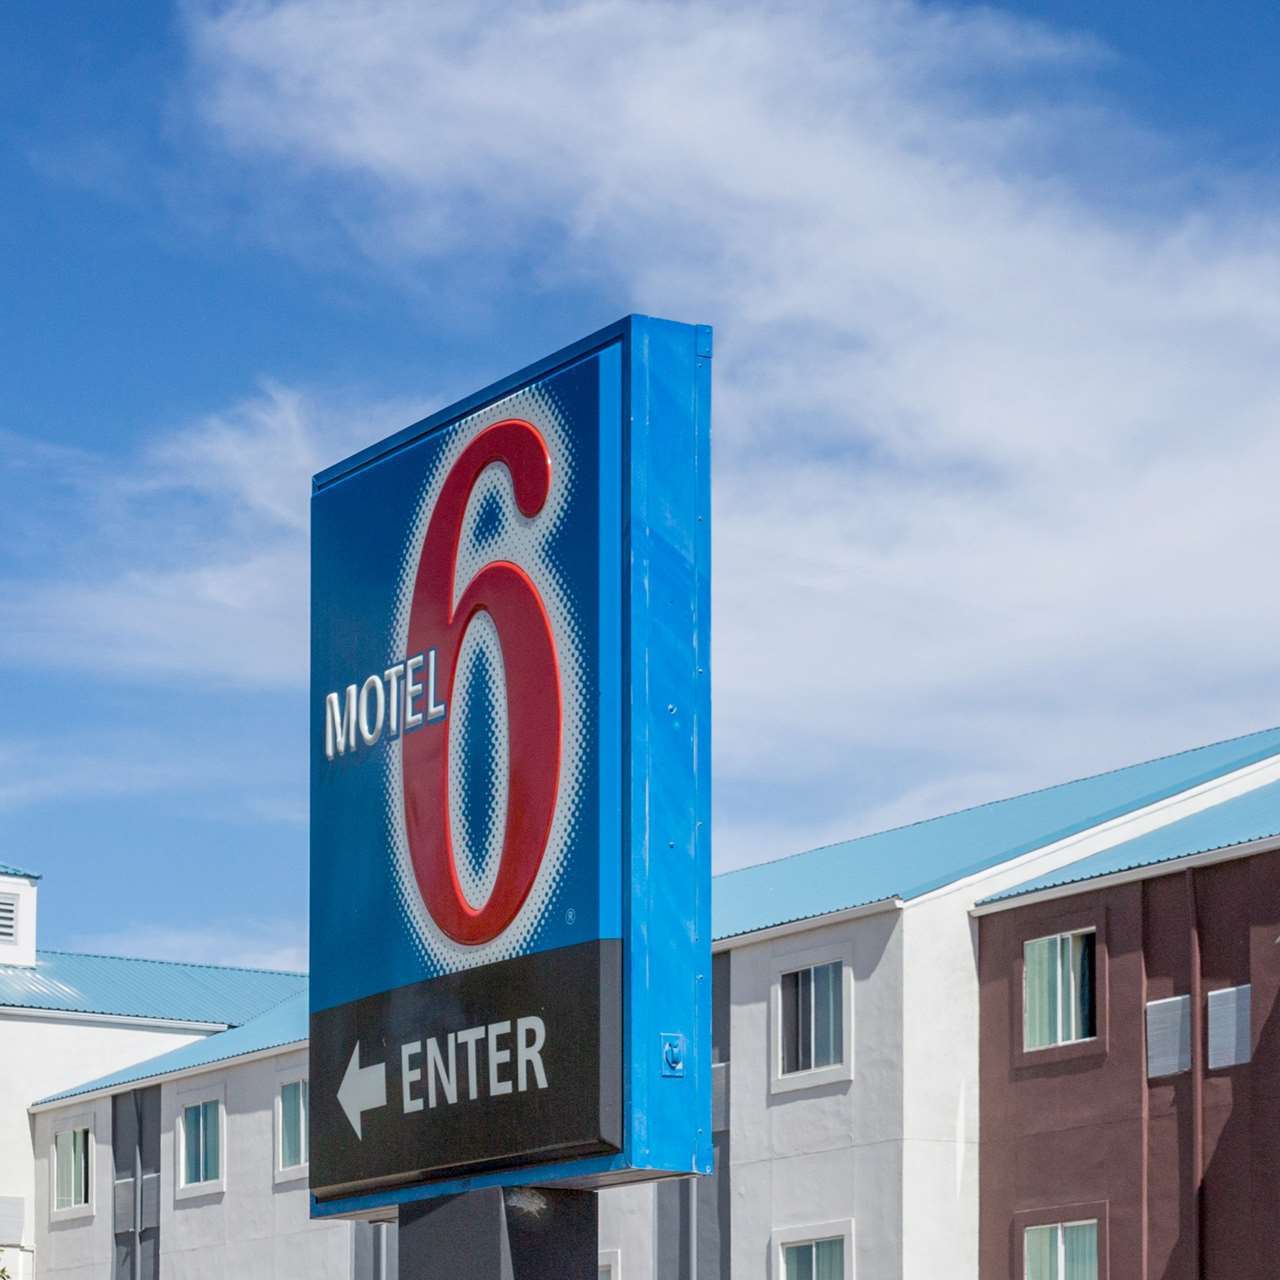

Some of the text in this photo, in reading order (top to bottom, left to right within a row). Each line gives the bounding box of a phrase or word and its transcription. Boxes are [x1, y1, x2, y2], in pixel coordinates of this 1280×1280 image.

[325, 418, 563, 946] MOTEL 6
[401, 1016, 549, 1113] ENTER
